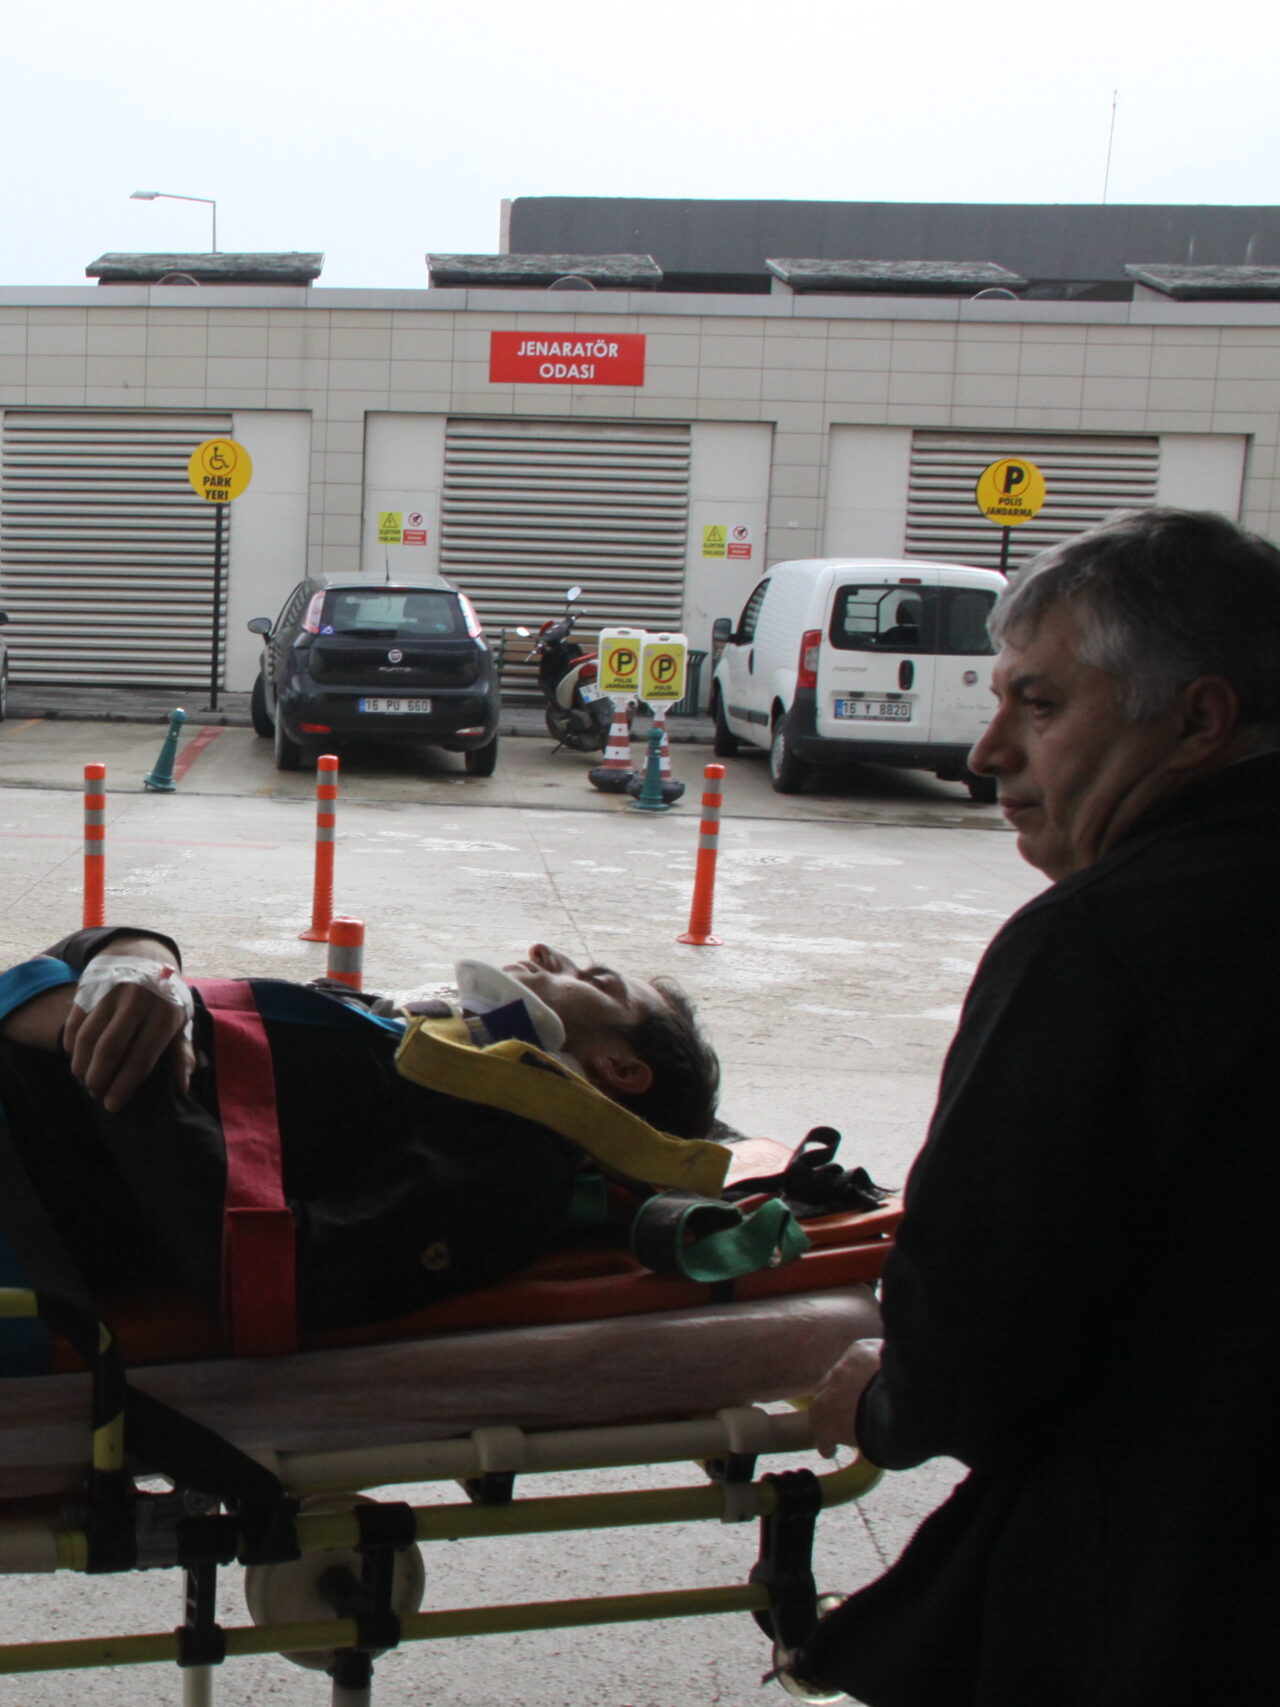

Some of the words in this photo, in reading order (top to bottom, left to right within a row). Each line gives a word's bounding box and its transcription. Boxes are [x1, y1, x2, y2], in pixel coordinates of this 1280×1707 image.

[517, 339, 619, 358] JENARATÖR
[539, 363, 595, 379] ODASI
[203, 475, 232, 488] PARK
[1003, 465, 1024, 494] P
[986, 506, 1033, 517] JANDARMA
[367, 700, 379, 711] 16
[387, 700, 400, 711] PU
[407, 701, 428, 712] 660
[843, 702, 857, 714] 16
[864, 703, 871, 715] Y
[879, 704, 908, 716] 8820
